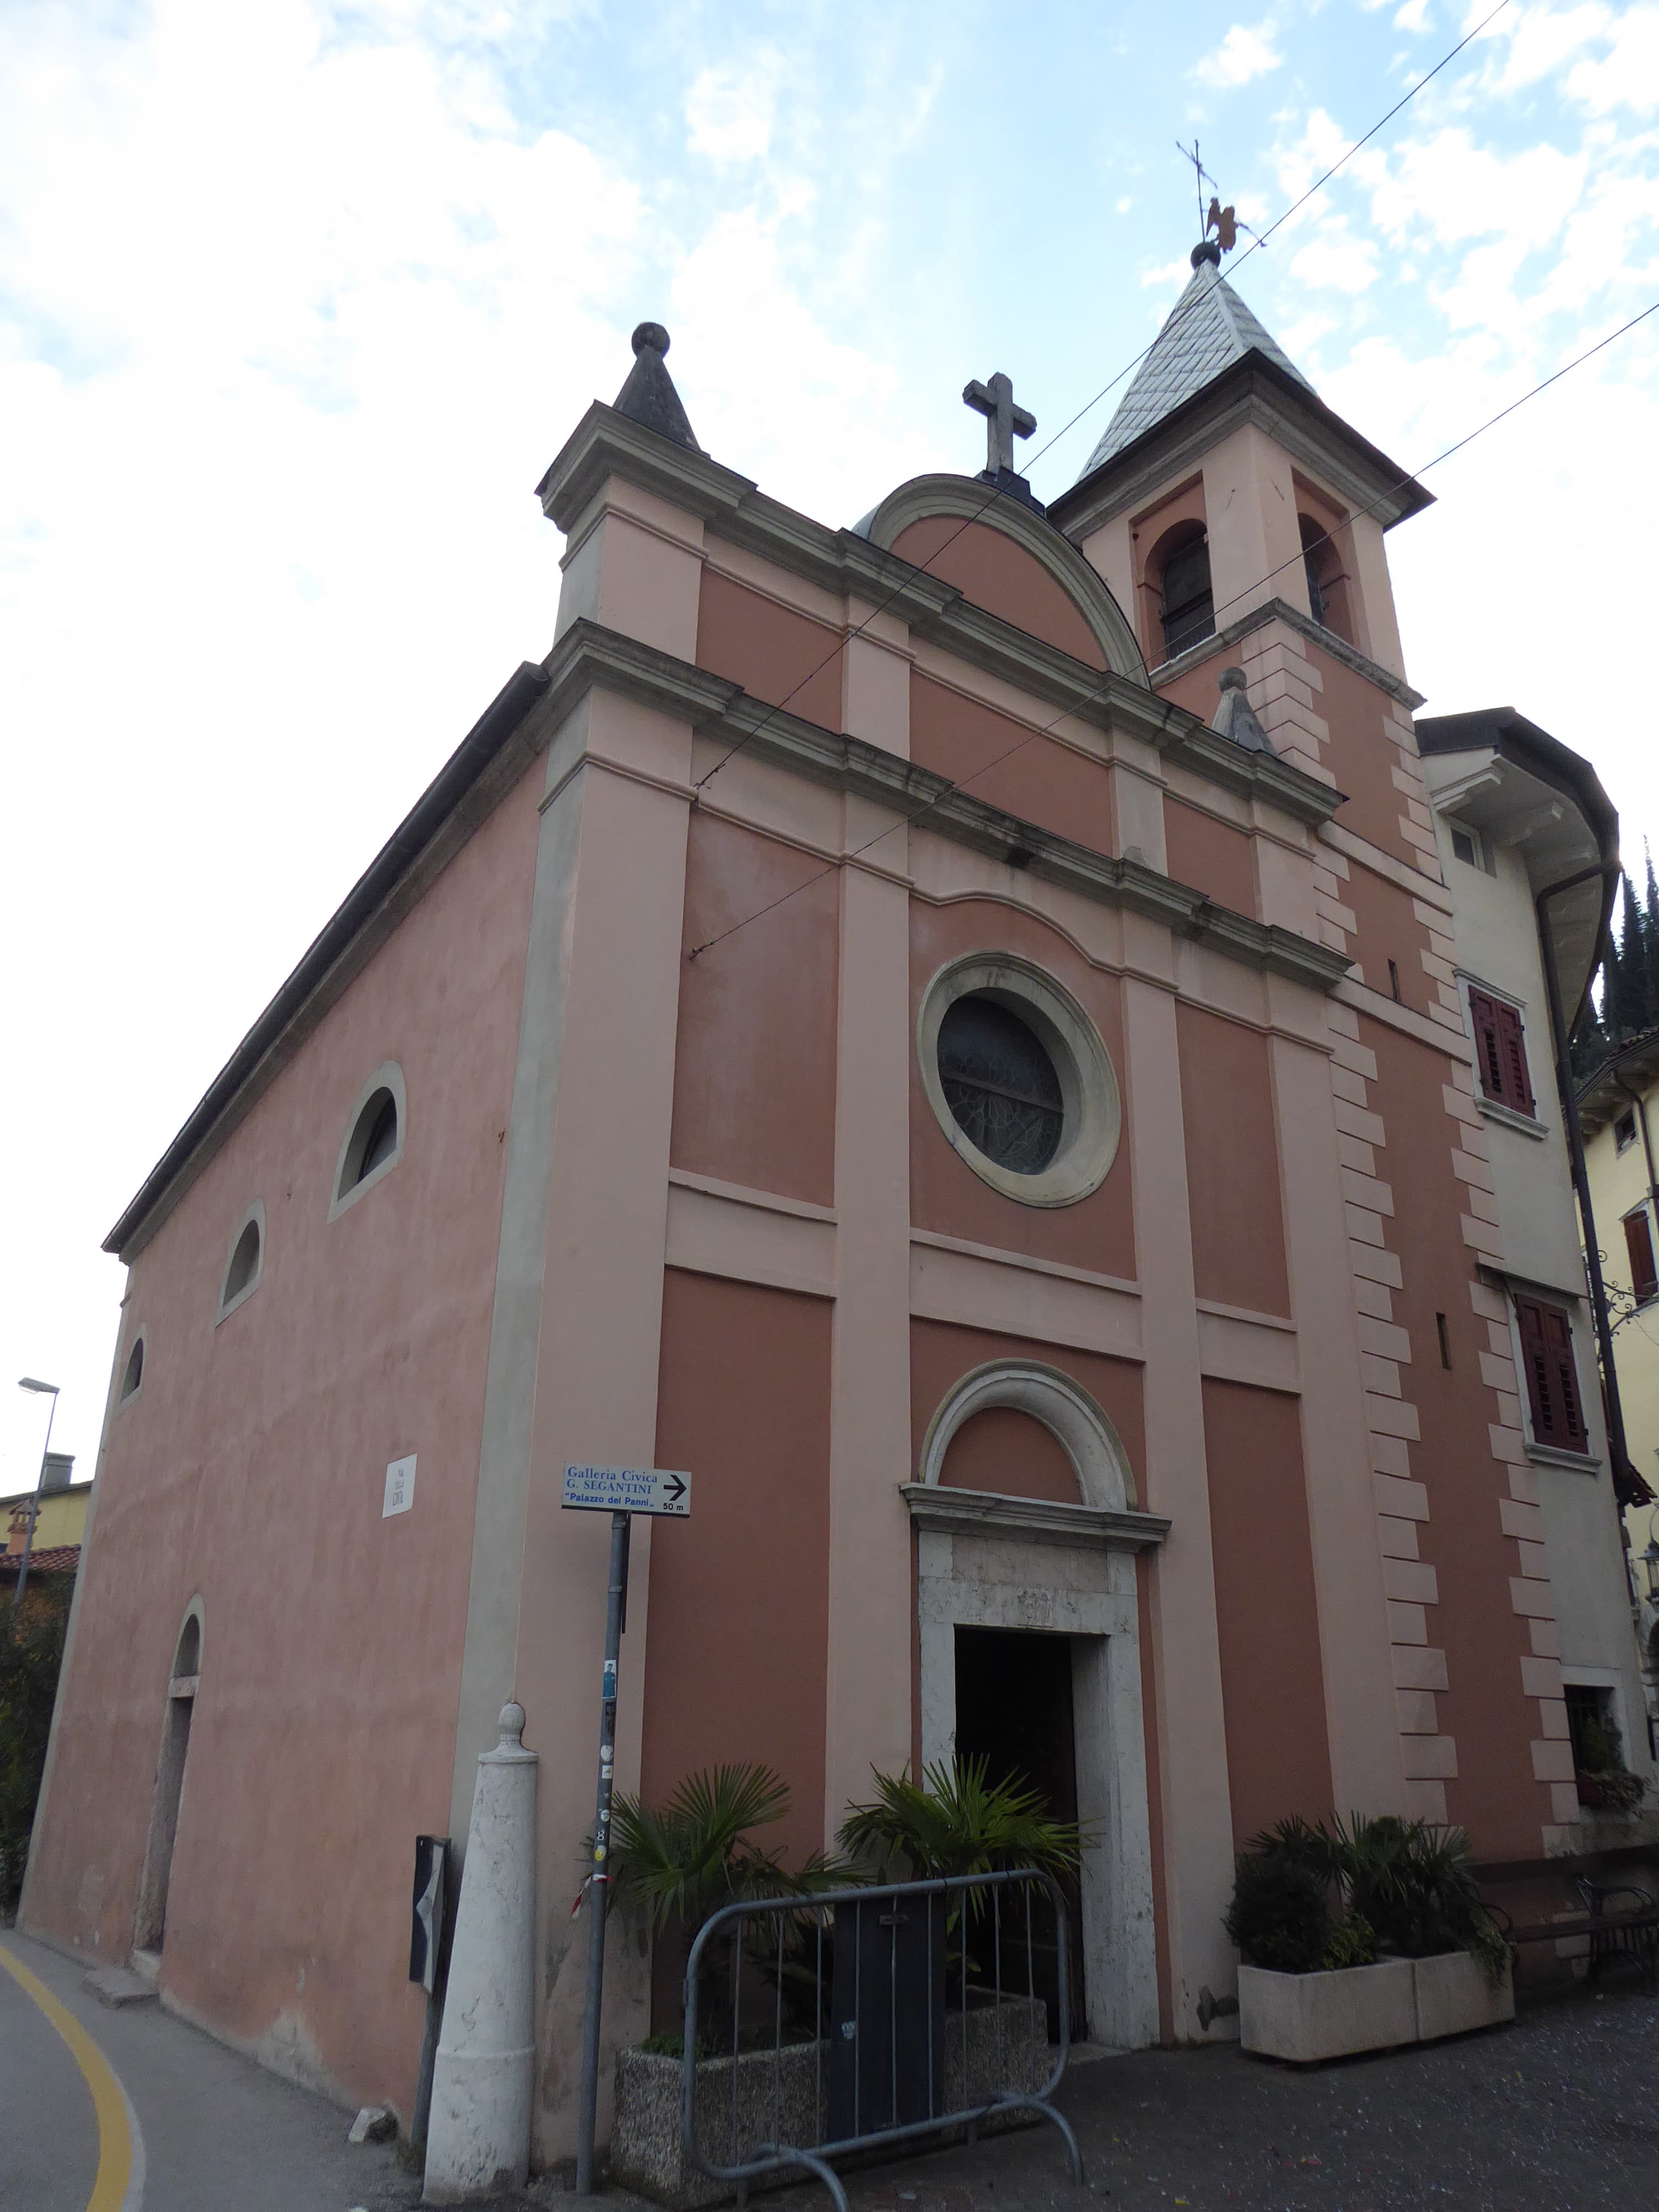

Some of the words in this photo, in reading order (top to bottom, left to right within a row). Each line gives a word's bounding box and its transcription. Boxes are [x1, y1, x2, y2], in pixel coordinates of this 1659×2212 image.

[568, 1467, 616, 1480] Galleria
[622, 1470, 658, 1483] Civica
[566, 1479, 578, 1488] G.
[583, 1480, 651, 1494] SEGANTINI
